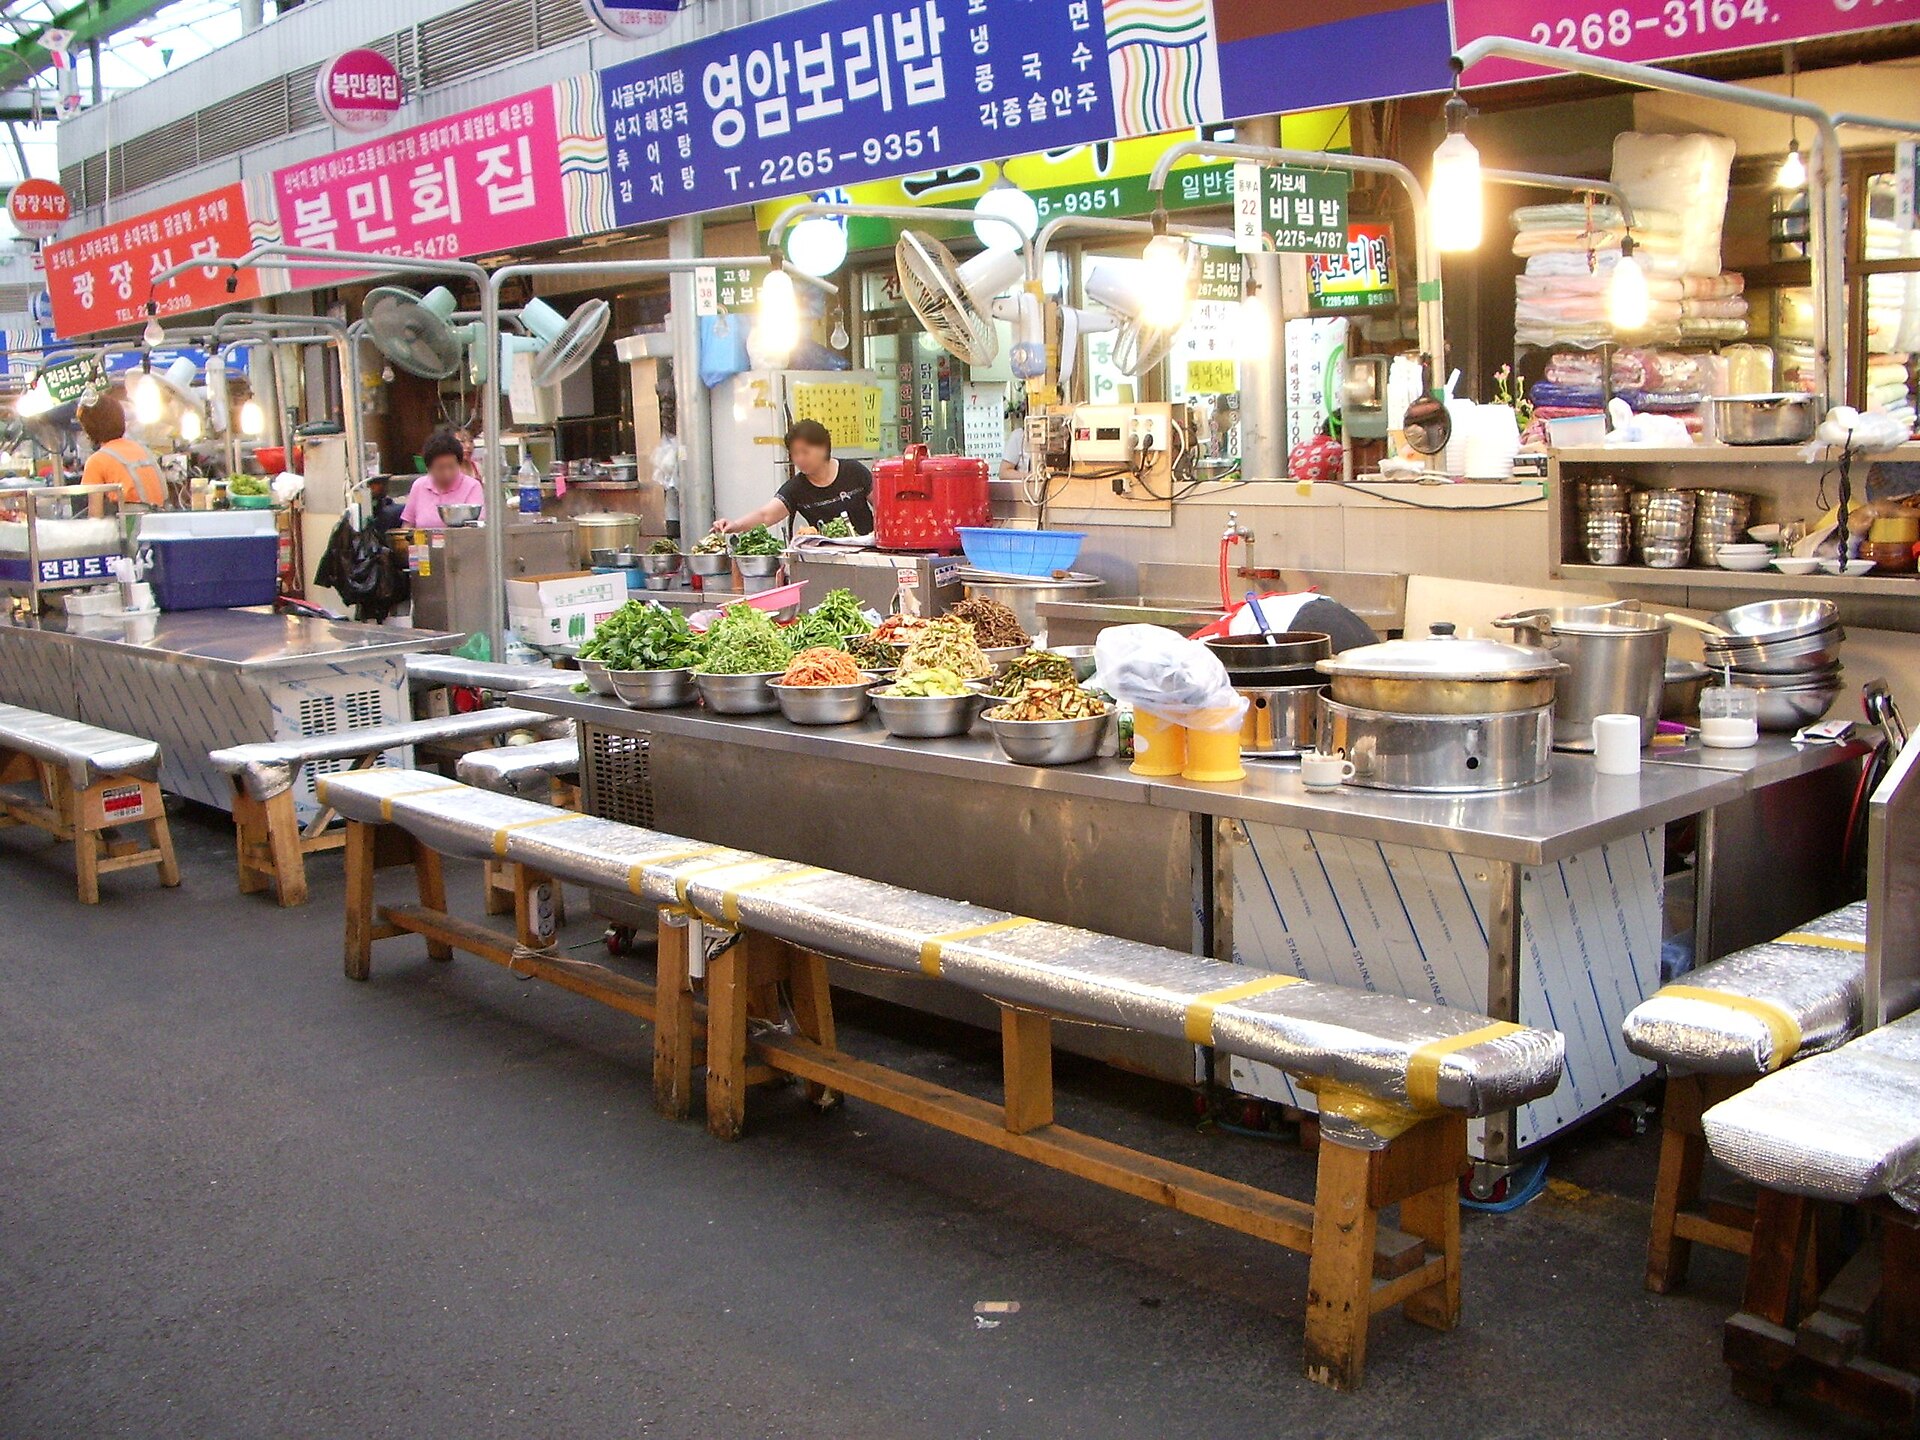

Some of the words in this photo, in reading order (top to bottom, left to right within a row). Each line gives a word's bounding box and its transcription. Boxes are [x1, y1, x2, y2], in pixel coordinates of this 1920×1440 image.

[702, 0, 946, 147] 영암보리밥
[332, 72, 398, 100] 복민회집
[610, 69, 684, 110] 사골우거지탕
[293, 135, 536, 252] 복민회집
[1269, 172, 1306, 194] 가보세
[14, 194, 66, 213] 광장식당
[1241, 199, 1257, 216] 22
[1269, 196, 1340, 228] 비빔밥
[1275, 229, 1343, 249] 2275-4787
[1203, 261, 1241, 283] 보리밥
[115, 307, 134, 323] TEL
